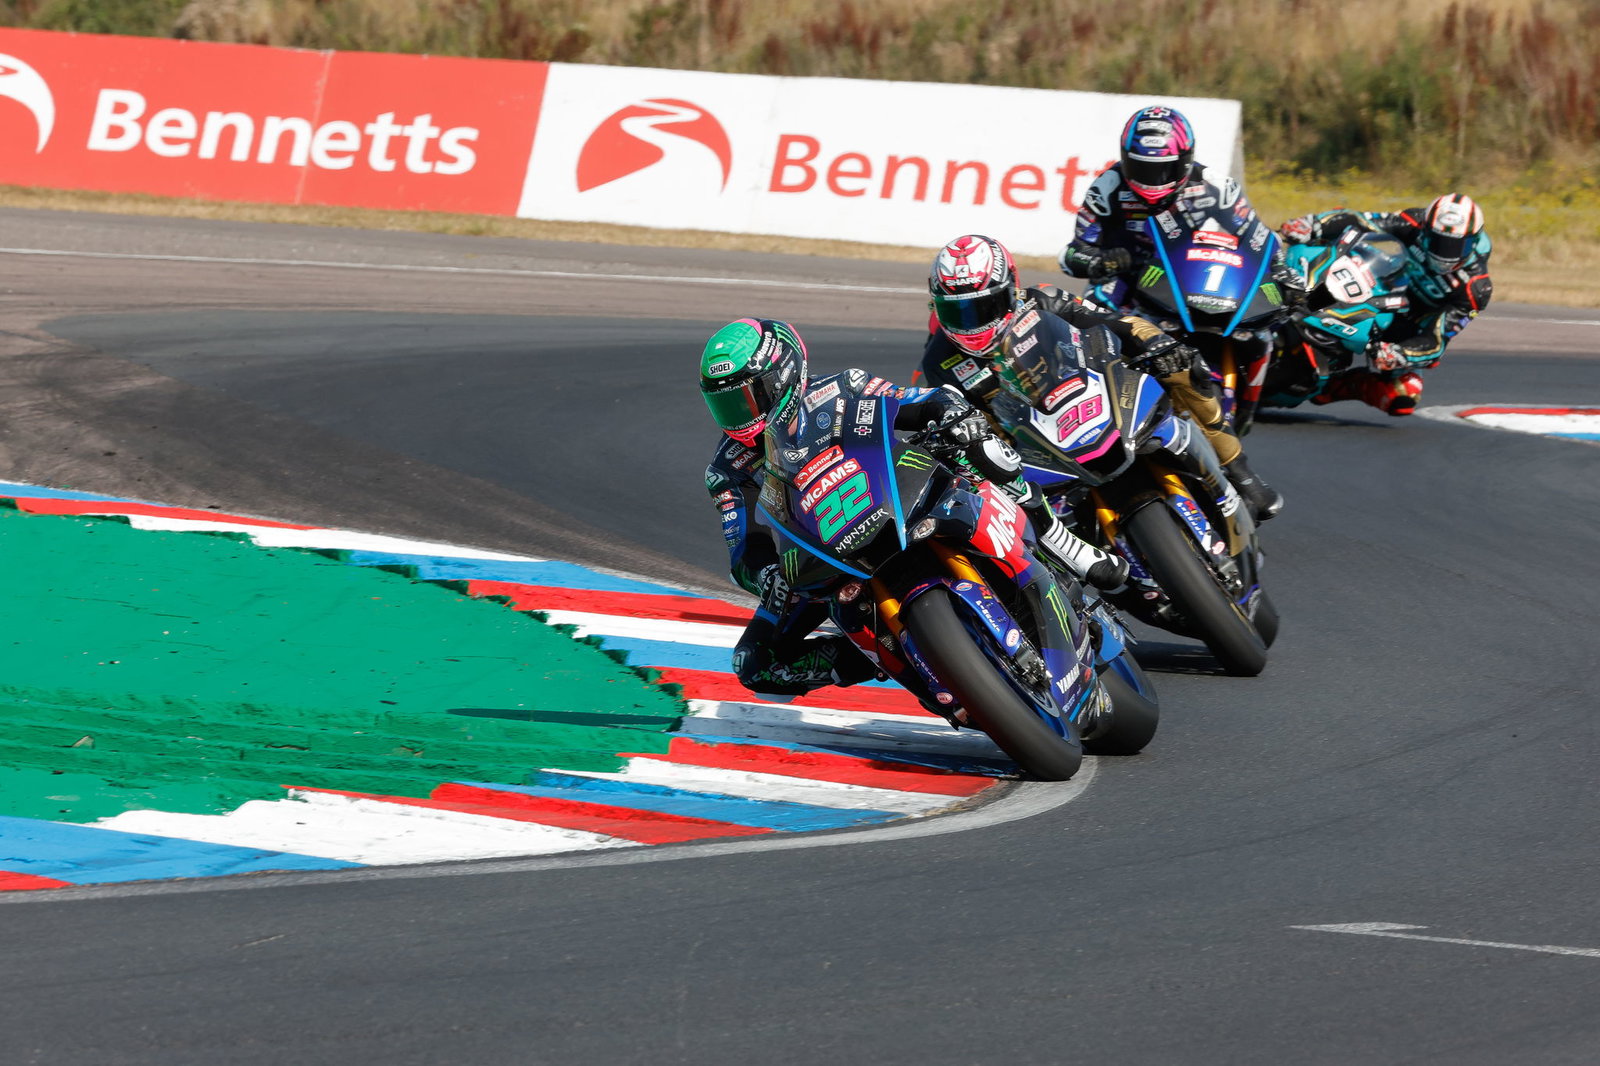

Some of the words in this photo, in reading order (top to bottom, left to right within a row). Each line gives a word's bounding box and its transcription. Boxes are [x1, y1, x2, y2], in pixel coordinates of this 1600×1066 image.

[87, 88, 480, 176] Bennetts
[768, 133, 1119, 215] Bennet
[1187, 249, 1243, 267] McAMS
[945, 275, 983, 287] SHARK
[1204, 264, 1227, 292] 1
[709, 362, 732, 375] SHOEI
[812, 384, 836, 401] YAMAHA
[1056, 394, 1103, 443] 28
[1077, 427, 1102, 445] YAMAHA
[728, 443, 743, 458] SHO
[808, 449, 840, 474] Bennet
[800, 459, 859, 512] McAMS
[814, 470, 874, 545] 22
[835, 508, 890, 554] MONSTER
